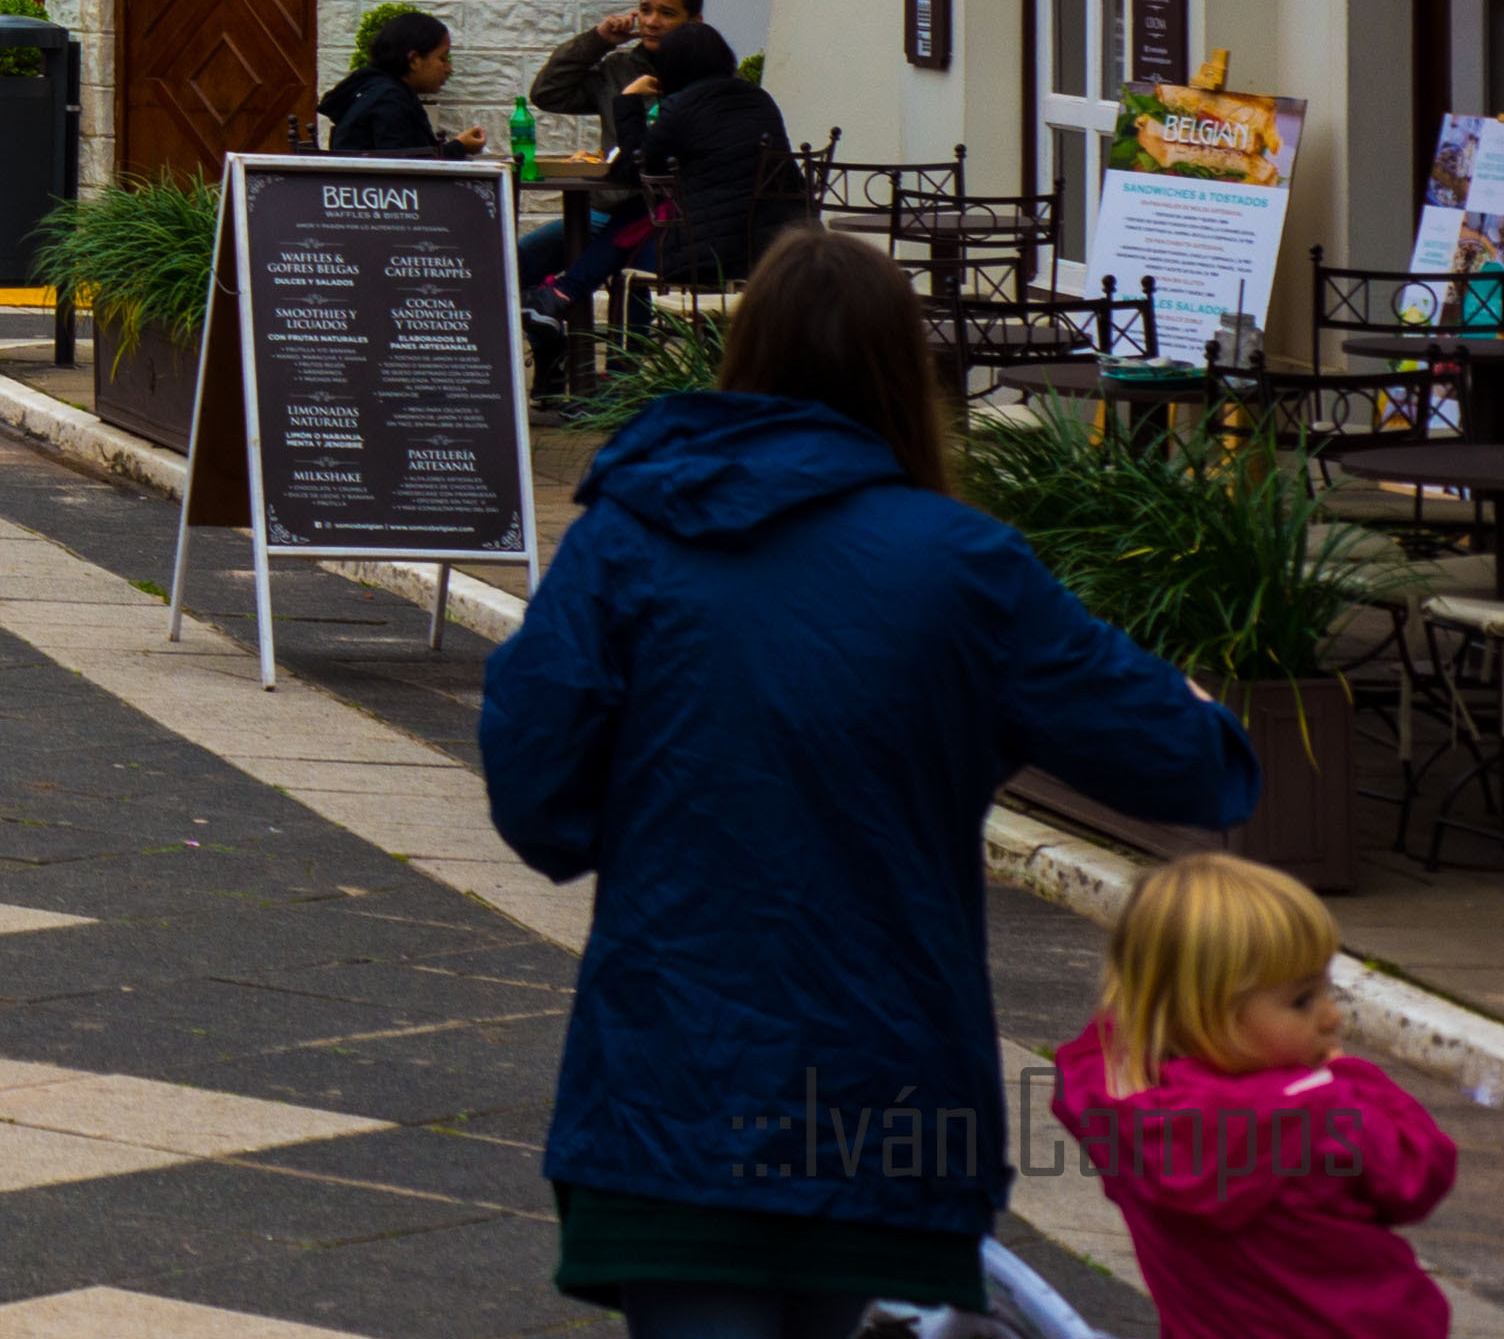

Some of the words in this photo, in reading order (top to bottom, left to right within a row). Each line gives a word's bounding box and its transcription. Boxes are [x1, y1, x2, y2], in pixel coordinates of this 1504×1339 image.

[1163, 114, 1249, 150] BELGIAN
[323, 185, 419, 210] BELGIAN
[1122, 182, 1197, 199] SANDWICHES
[1209, 191, 1269, 208] TOSTADOS
[325, 211, 372, 219] WAFFLES
[383, 212, 420, 220] BISTRO
[281, 252, 332, 263] WAFFLES
[337, 253, 345, 264] &
[390, 255, 454, 267] CAFETERÍA
[456, 258, 465, 268] Y
[267, 263, 313, 274] GOFRES
[317, 264, 360, 274] BELGAS
[274, 277, 307, 285] DULCES
[406, 298, 456, 309] COCINA
[1175, 300, 1229, 316] SALADOS
[274, 308, 347, 319] SMOOTHIES
[349, 310, 357, 320] Y
[286, 319, 348, 330] LICUADOS
[395, 320, 403, 330] Y
[406, 320, 469, 331] TOSTADOS
[268, 333, 286, 341] CON
[288, 334, 319, 342] FRUTAS
[320, 335, 369, 343] NATURALES
[398, 334, 455, 342] ELABORADOS
[419, 343, 478, 351] ARTESANALES
[286, 405, 359, 417] LIMONADAS
[290, 416, 358, 428] NATURALES
[285, 431, 313, 439] LIMÓN
[324, 441, 364, 449] JENGIBRE
[407, 448, 476, 461] PASTELERÍA
[408, 461, 476, 472] ARTESANAL
[293, 470, 362, 483] MILKSHAKE
